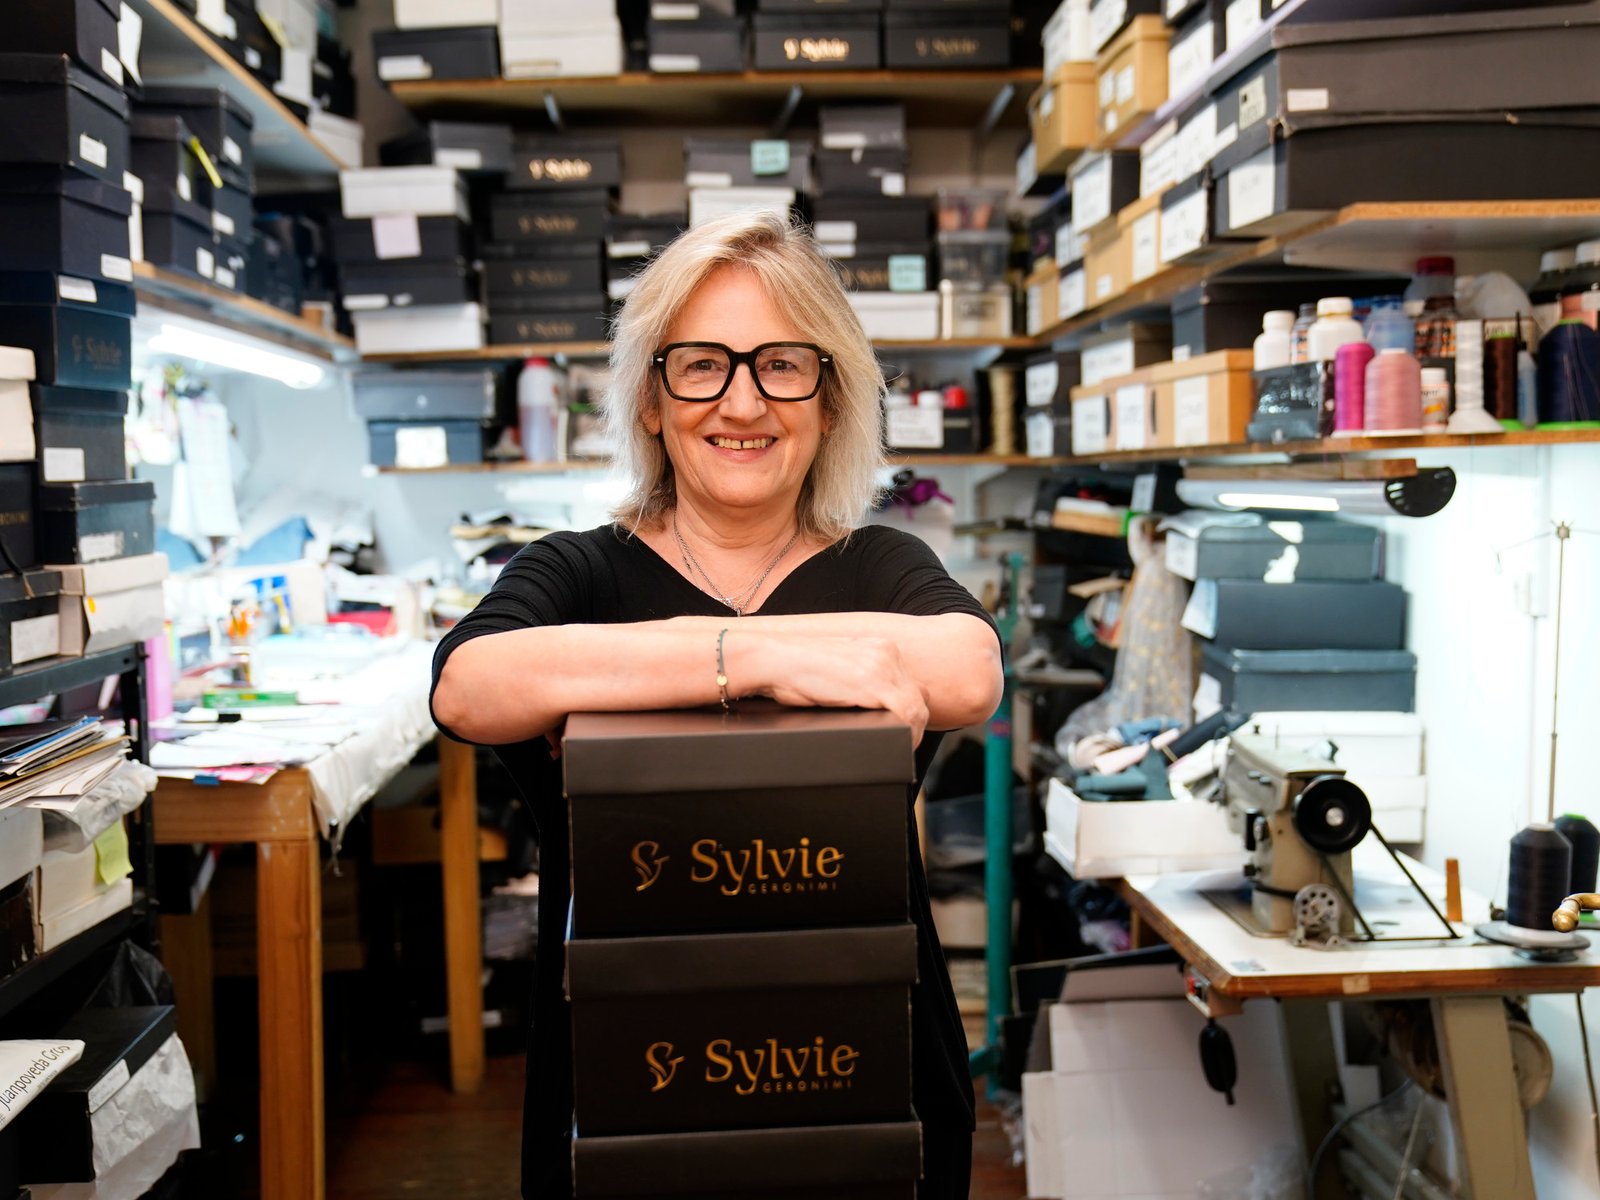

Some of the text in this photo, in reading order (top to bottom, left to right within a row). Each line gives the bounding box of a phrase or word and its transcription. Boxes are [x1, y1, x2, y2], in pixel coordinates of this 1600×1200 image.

[691, 838, 844, 896] Sylvie
[748, 882, 836, 894] GERONIMI
[705, 1037, 859, 1095] Sylvie
[763, 1081, 851, 1092] GERONIMI
